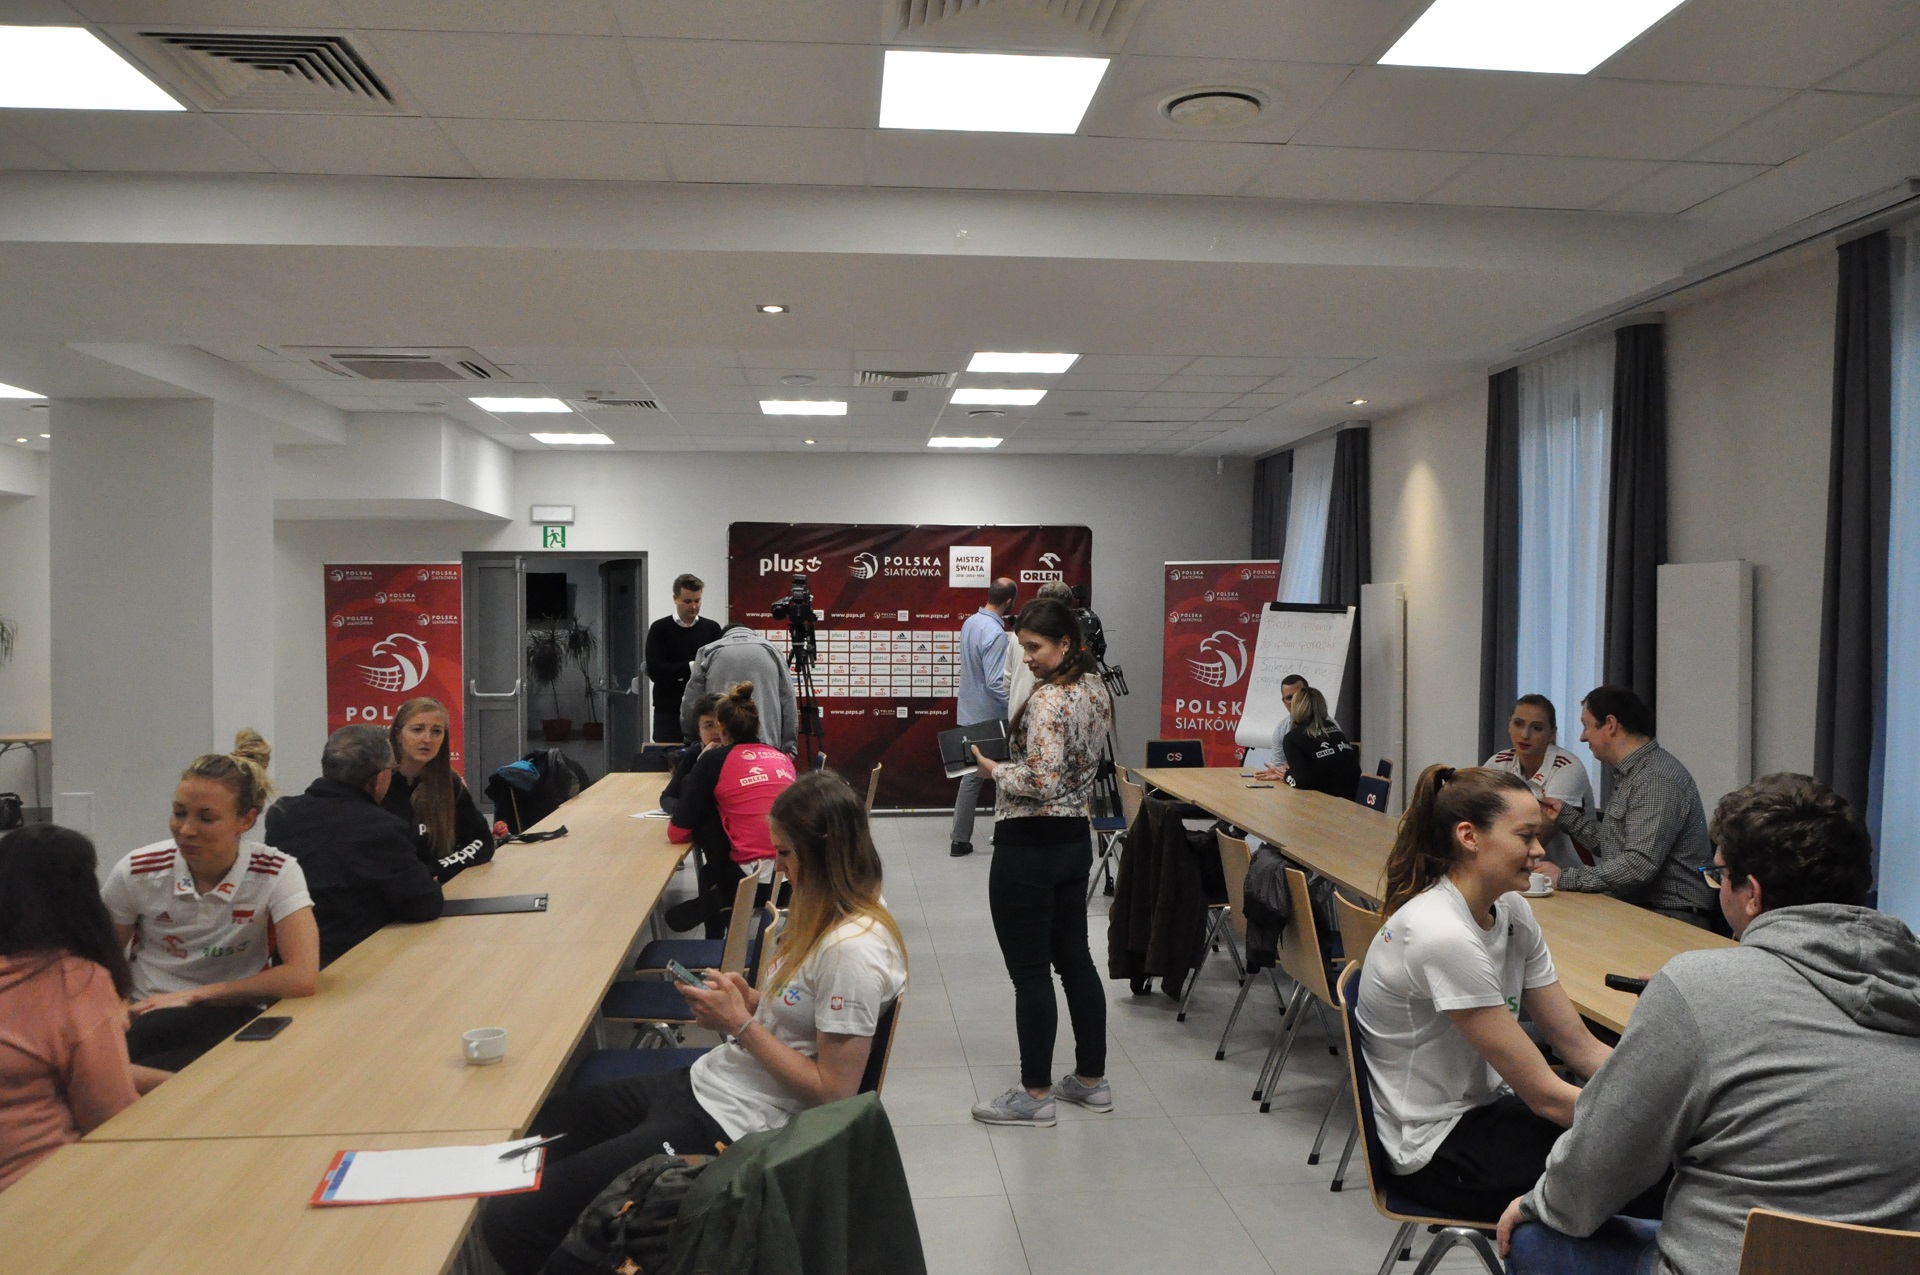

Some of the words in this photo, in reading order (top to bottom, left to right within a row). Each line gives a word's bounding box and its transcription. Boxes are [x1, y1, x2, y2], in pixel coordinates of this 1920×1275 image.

[760, 554, 804, 576] plus
[884, 556, 942, 567] POLSKA
[956, 556, 985, 564] MISTRZ
[884, 566, 942, 577] SIATKÓWKA
[956, 564, 985, 572] ŚWIATA
[1023, 572, 1060, 582] ORLEN
[831, 610, 865, 618] www.pzps.pl
[1176, 699, 1243, 716] POLSK
[346, 706, 401, 721] POL
[1176, 716, 1238, 732] SIATKÓW
[1166, 752, 1182, 761] CS
[742, 775, 766, 785] ORLEN
[1367, 794, 1376, 805] CS
